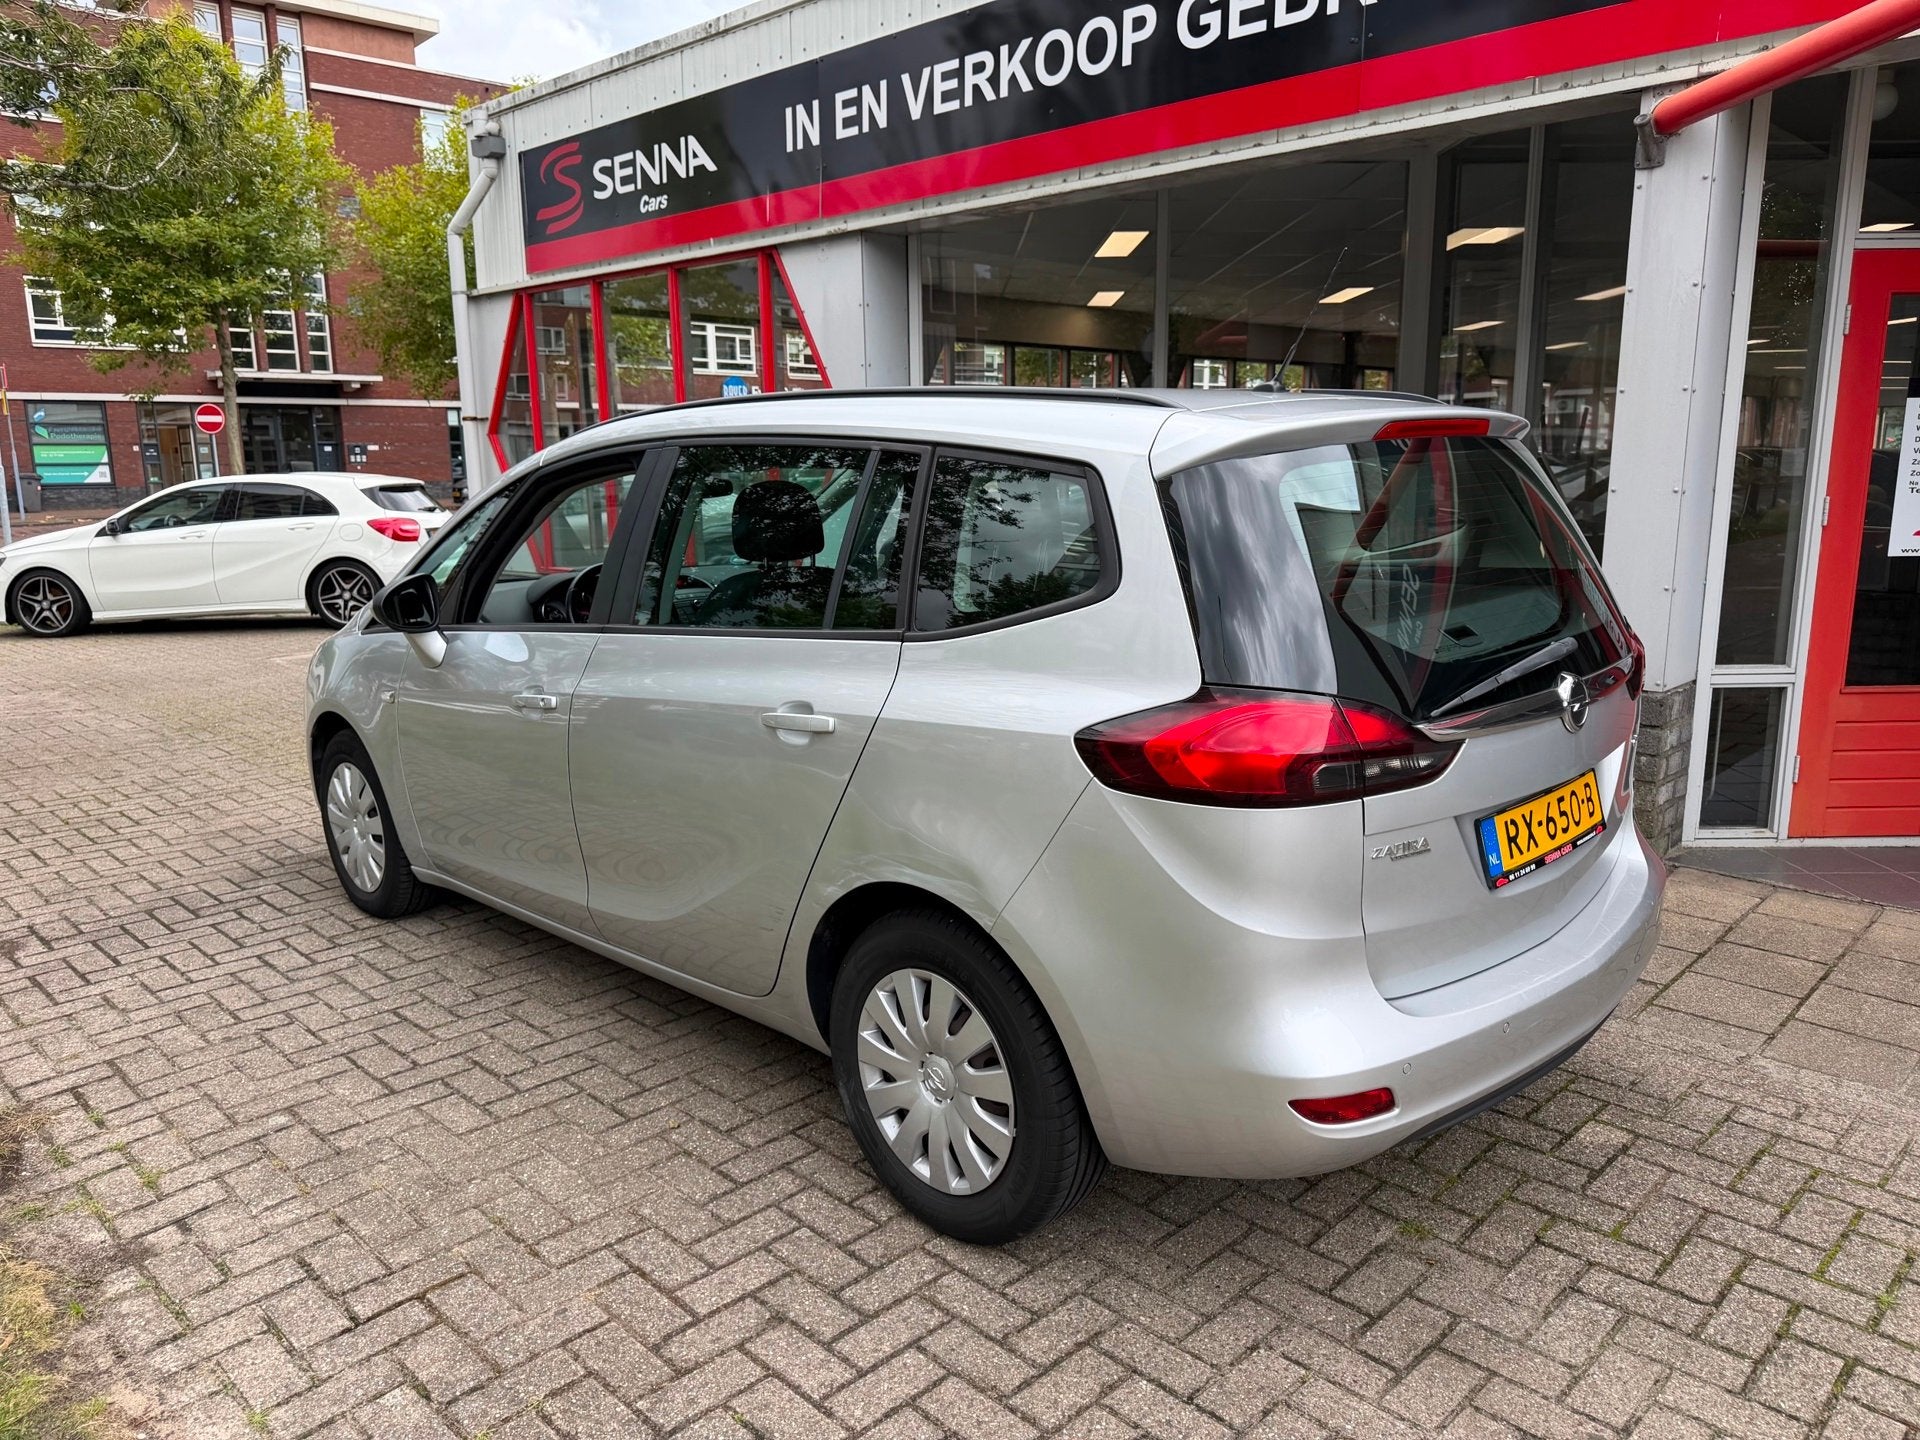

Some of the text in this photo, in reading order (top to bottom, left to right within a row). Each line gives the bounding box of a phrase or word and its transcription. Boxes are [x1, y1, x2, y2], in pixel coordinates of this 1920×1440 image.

[785, 0, 1378, 152] IN EN VERKOOP GE
[592, 135, 718, 200] SENNA
[639, 194, 668, 213] Cars
[1504, 782, 1595, 860] RX-650-B
[1371, 837, 1430, 859] ZAFIRA
[1489, 853, 1500, 866] NL
